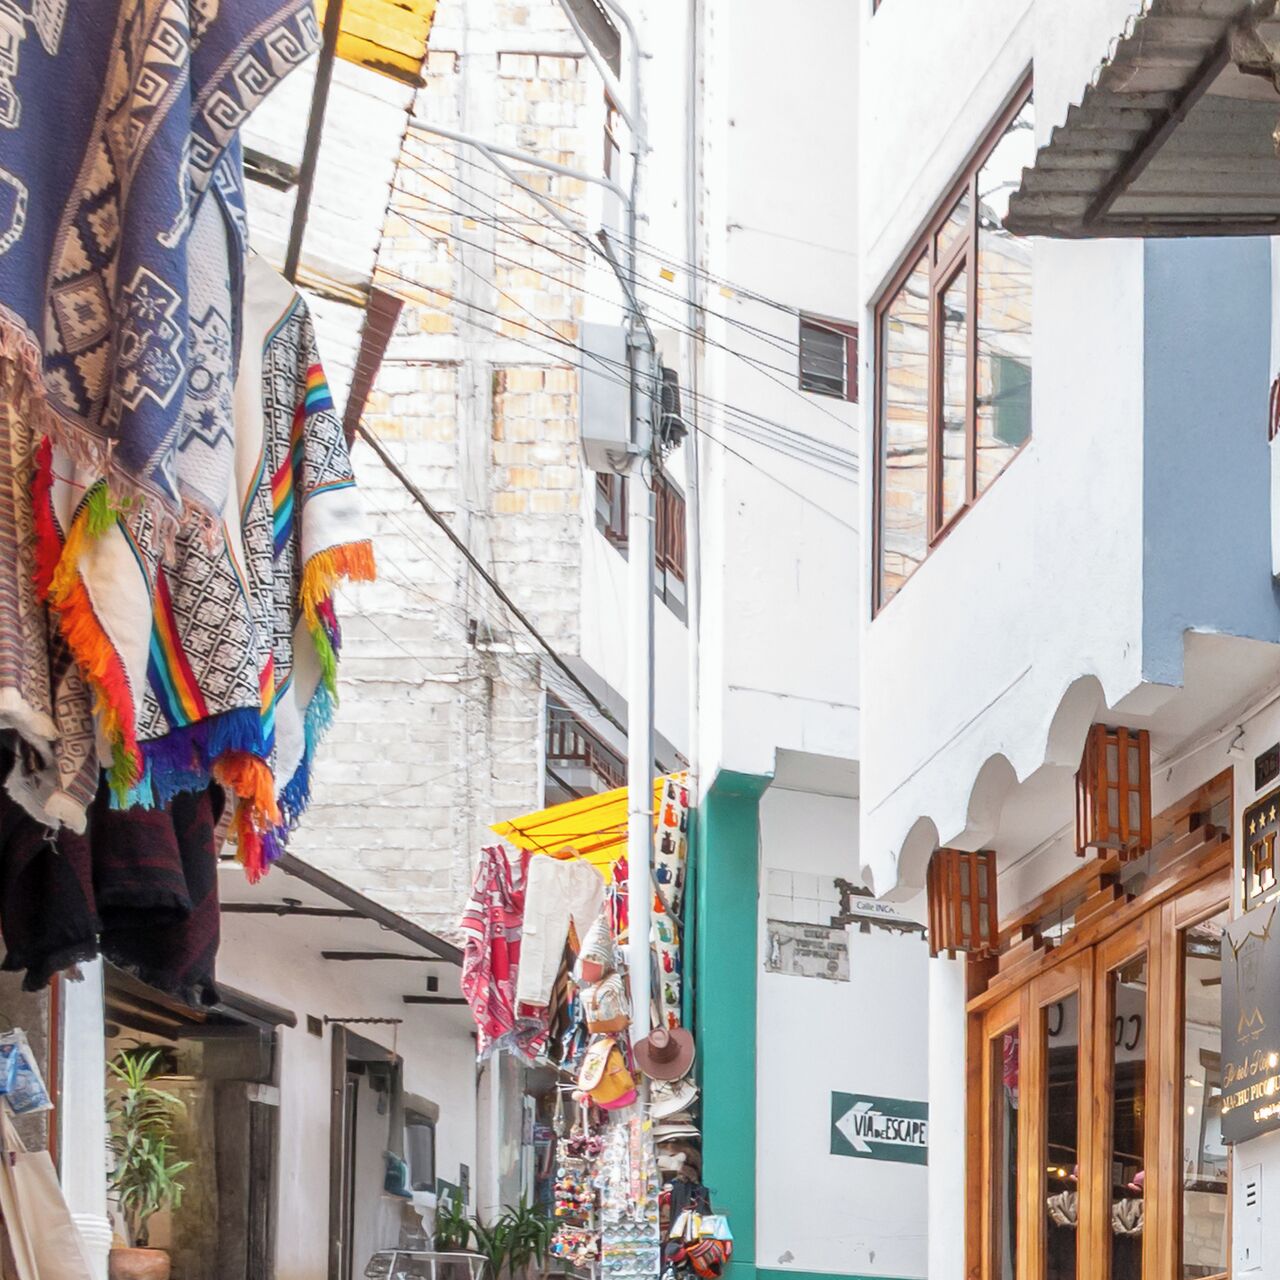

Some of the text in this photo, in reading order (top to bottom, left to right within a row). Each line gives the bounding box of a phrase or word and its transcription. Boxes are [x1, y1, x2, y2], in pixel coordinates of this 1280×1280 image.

[1250, 831, 1278, 899] H
[853, 1113, 873, 1137] VIA
[886, 1117, 926, 1144] ESCAPE
